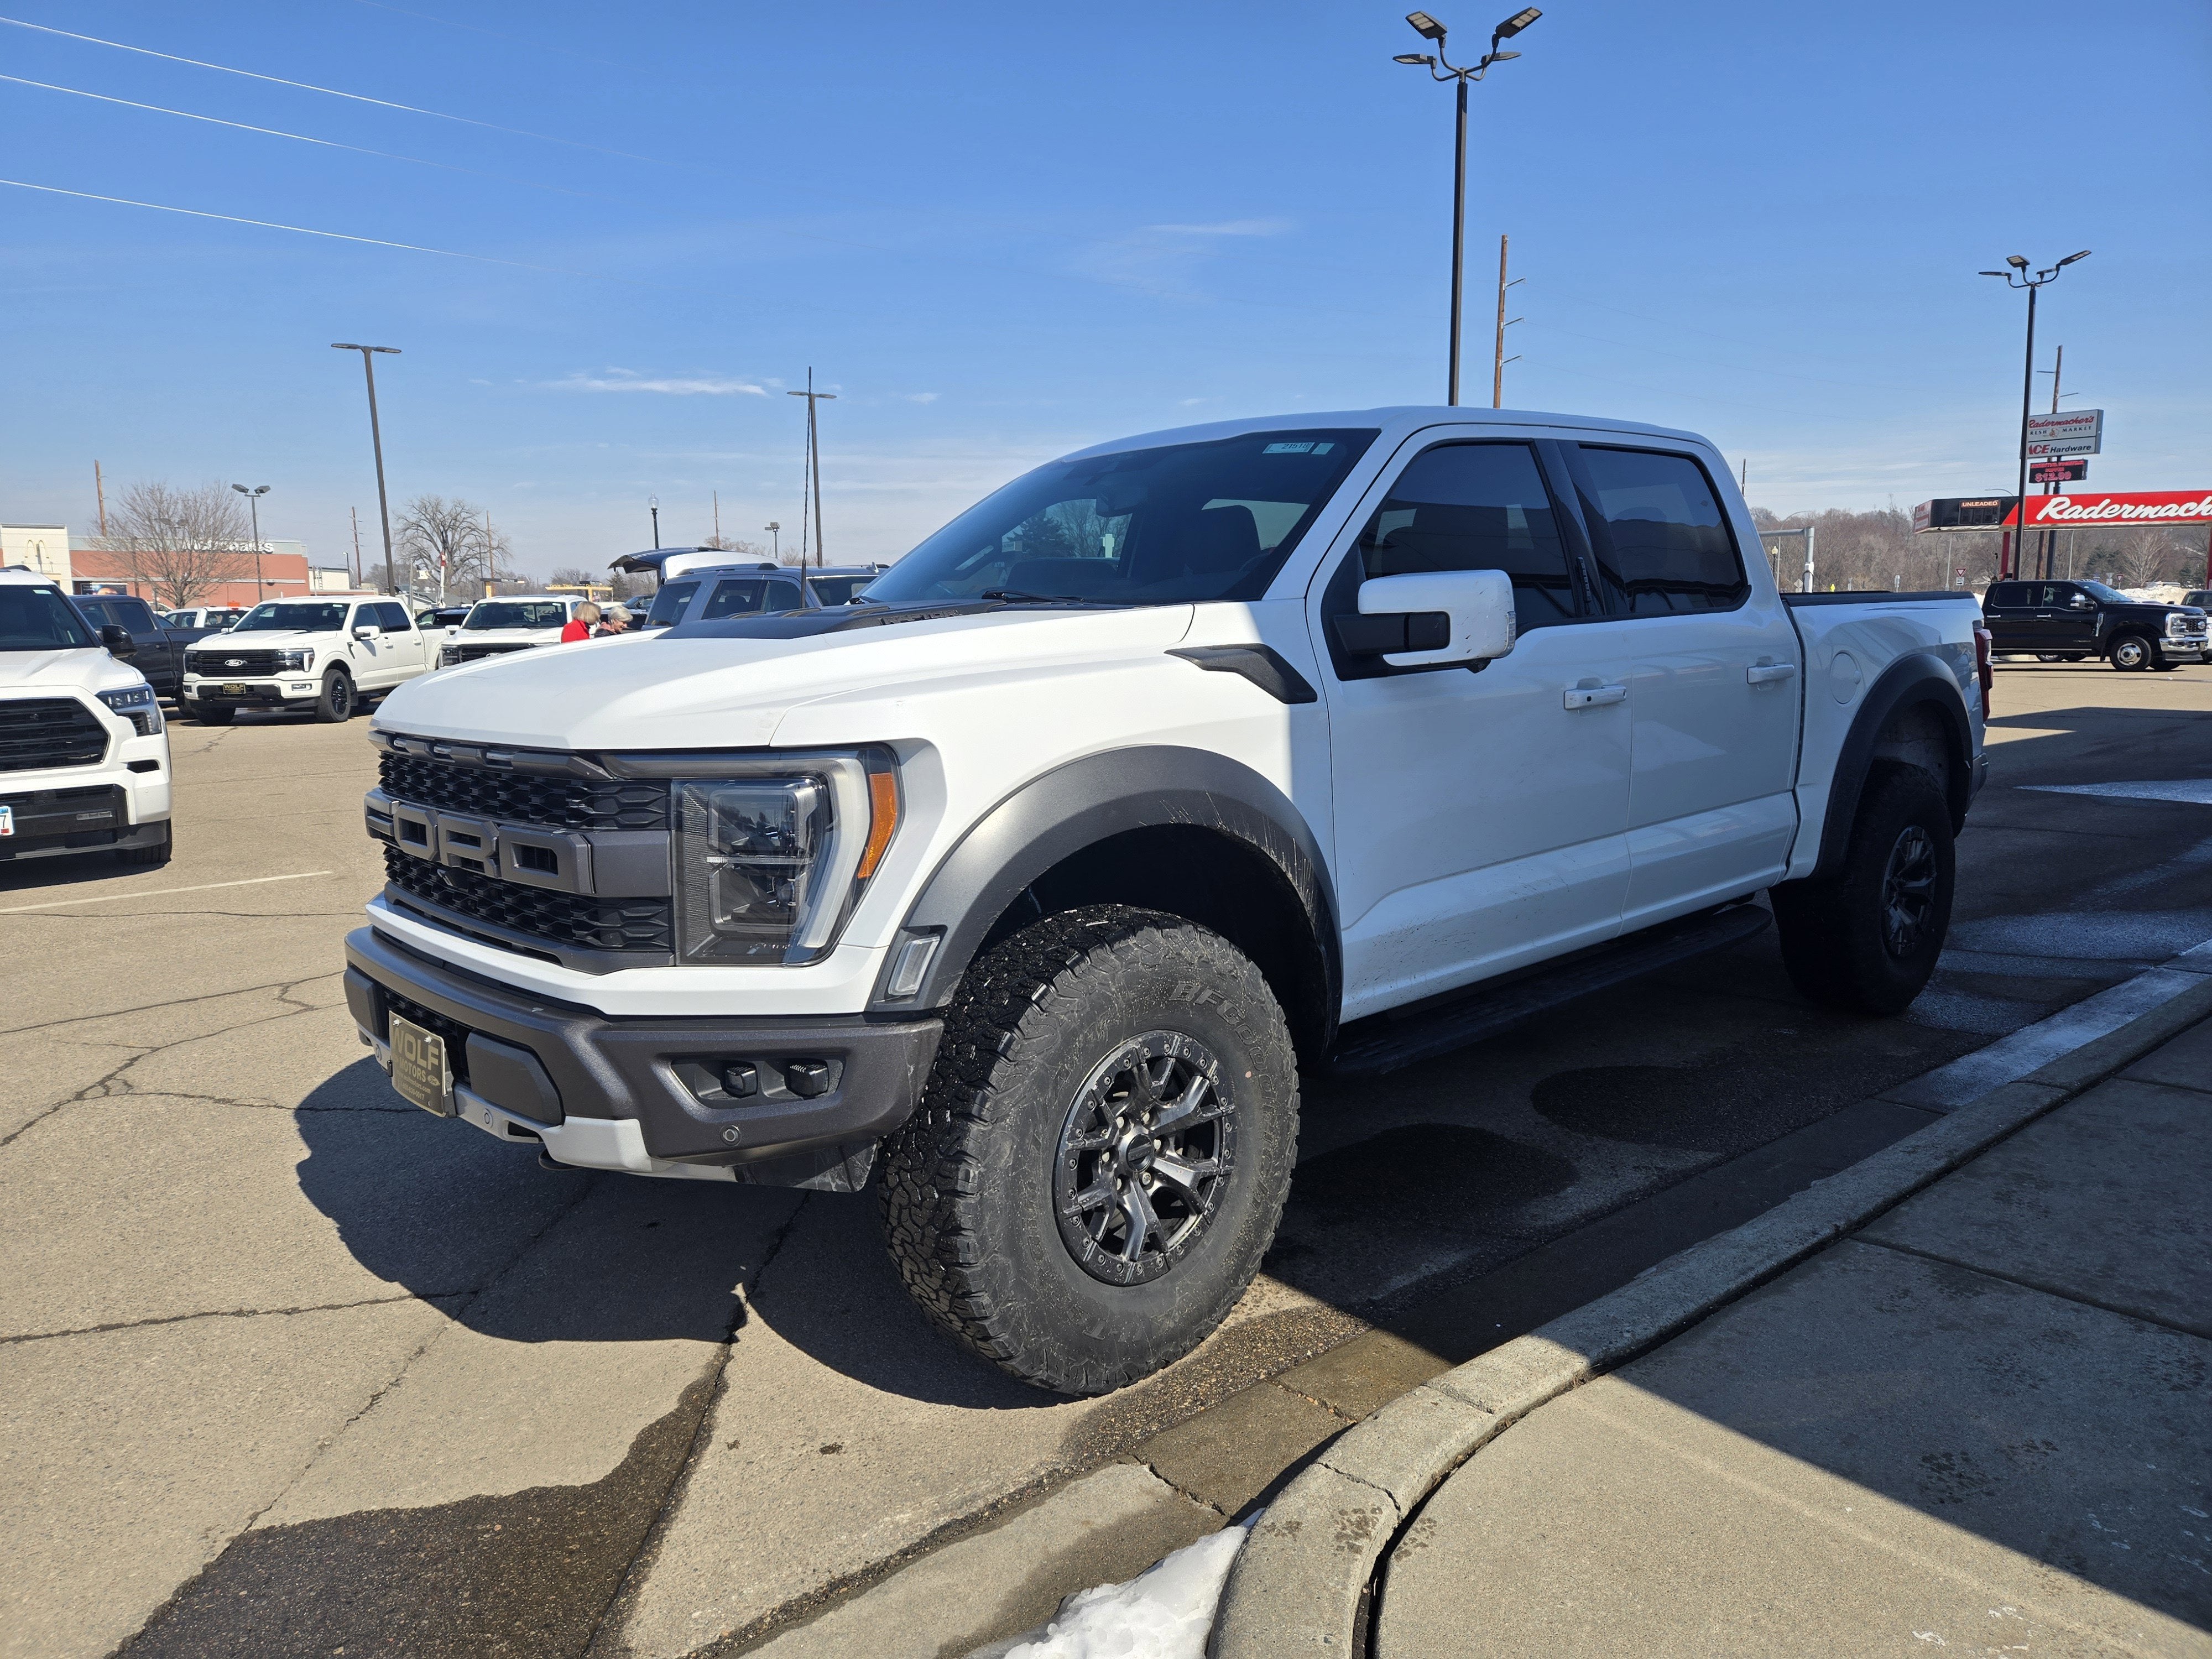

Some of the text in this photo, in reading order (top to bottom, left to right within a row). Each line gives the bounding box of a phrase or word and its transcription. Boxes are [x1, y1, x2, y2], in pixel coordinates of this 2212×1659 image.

[2050, 445, 2091, 453] Hardware
[364, 789, 596, 895] FORD
[392, 1027, 439, 1071] WOLF
[398, 1056, 427, 1083] MOTORS
